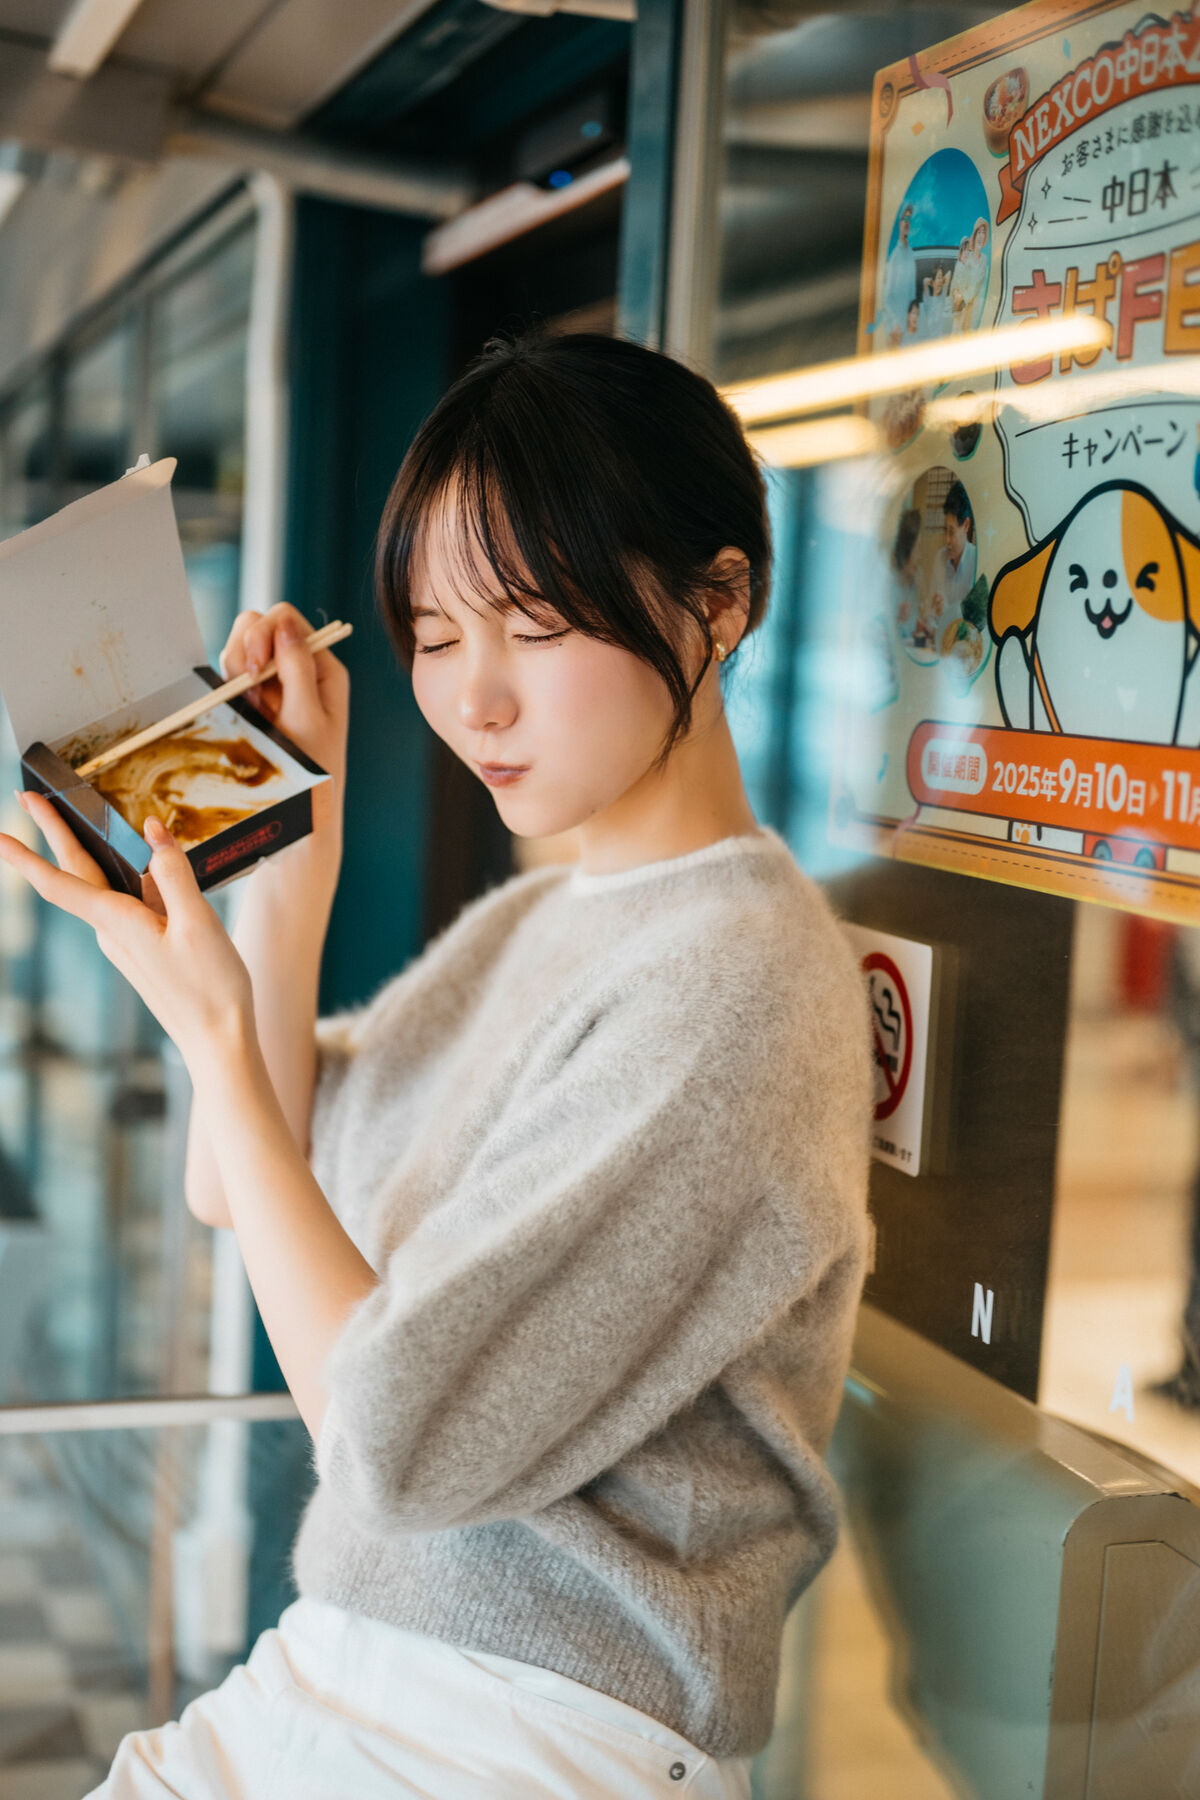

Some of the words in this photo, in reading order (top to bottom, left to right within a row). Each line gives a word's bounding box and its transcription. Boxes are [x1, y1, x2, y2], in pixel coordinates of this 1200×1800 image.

[1102, 159, 1179, 223] 中日本
[1062, 420, 1187, 469] キャンペーン
[991, 758, 1147, 817] 2025年9月10日
[971, 1282, 995, 1345] N
[1109, 1363, 1135, 1424] A
